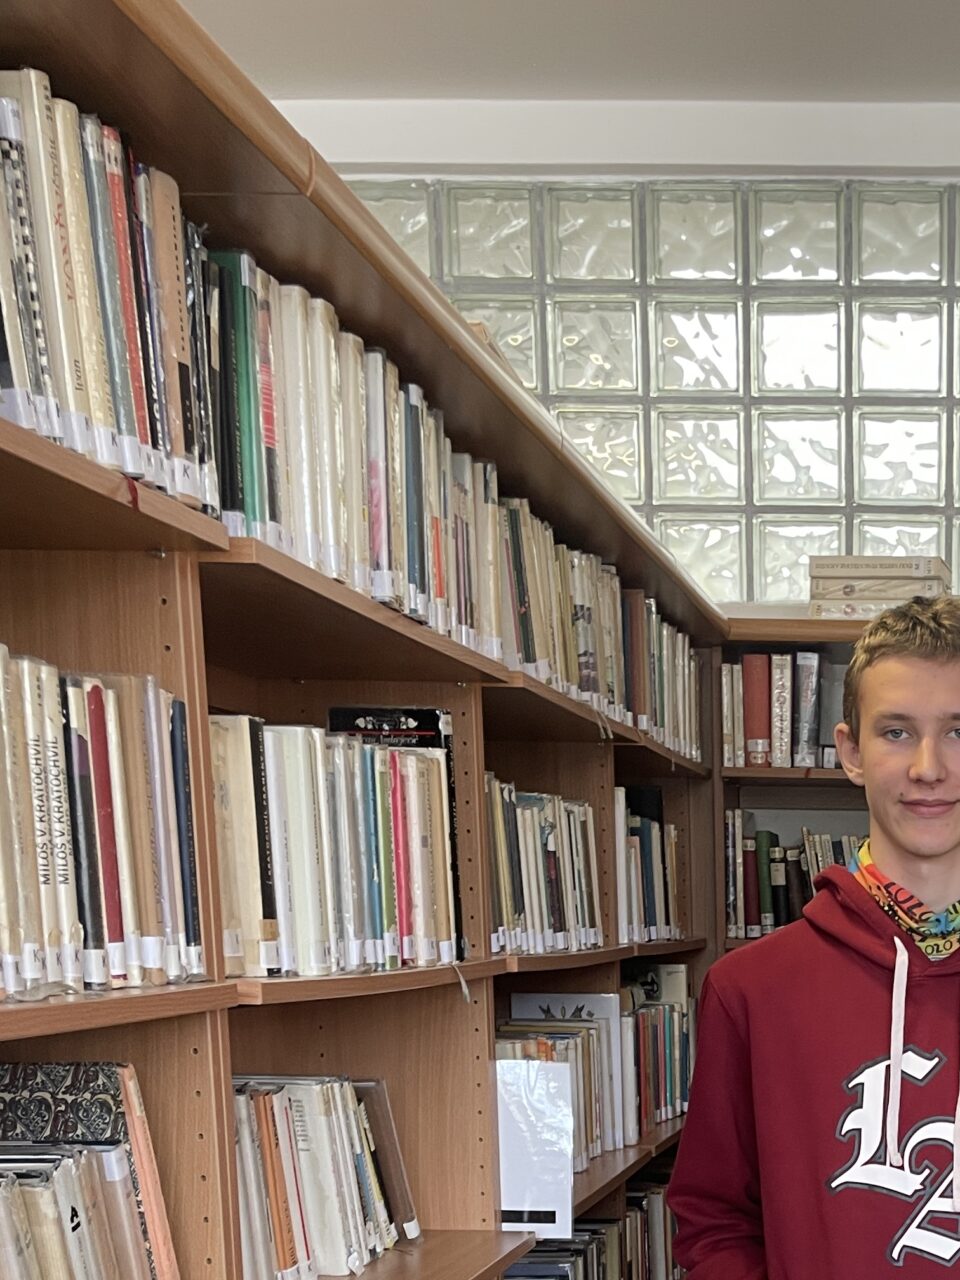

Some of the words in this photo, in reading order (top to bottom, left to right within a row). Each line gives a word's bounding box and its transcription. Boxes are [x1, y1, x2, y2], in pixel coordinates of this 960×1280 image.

[29, 734, 46, 823] KRATOCHVÍL
[46, 736, 63, 822] KRATOCHVÍL
[38, 841, 51, 886] MILOŠ
[56, 840, 70, 886] MILOŠ
